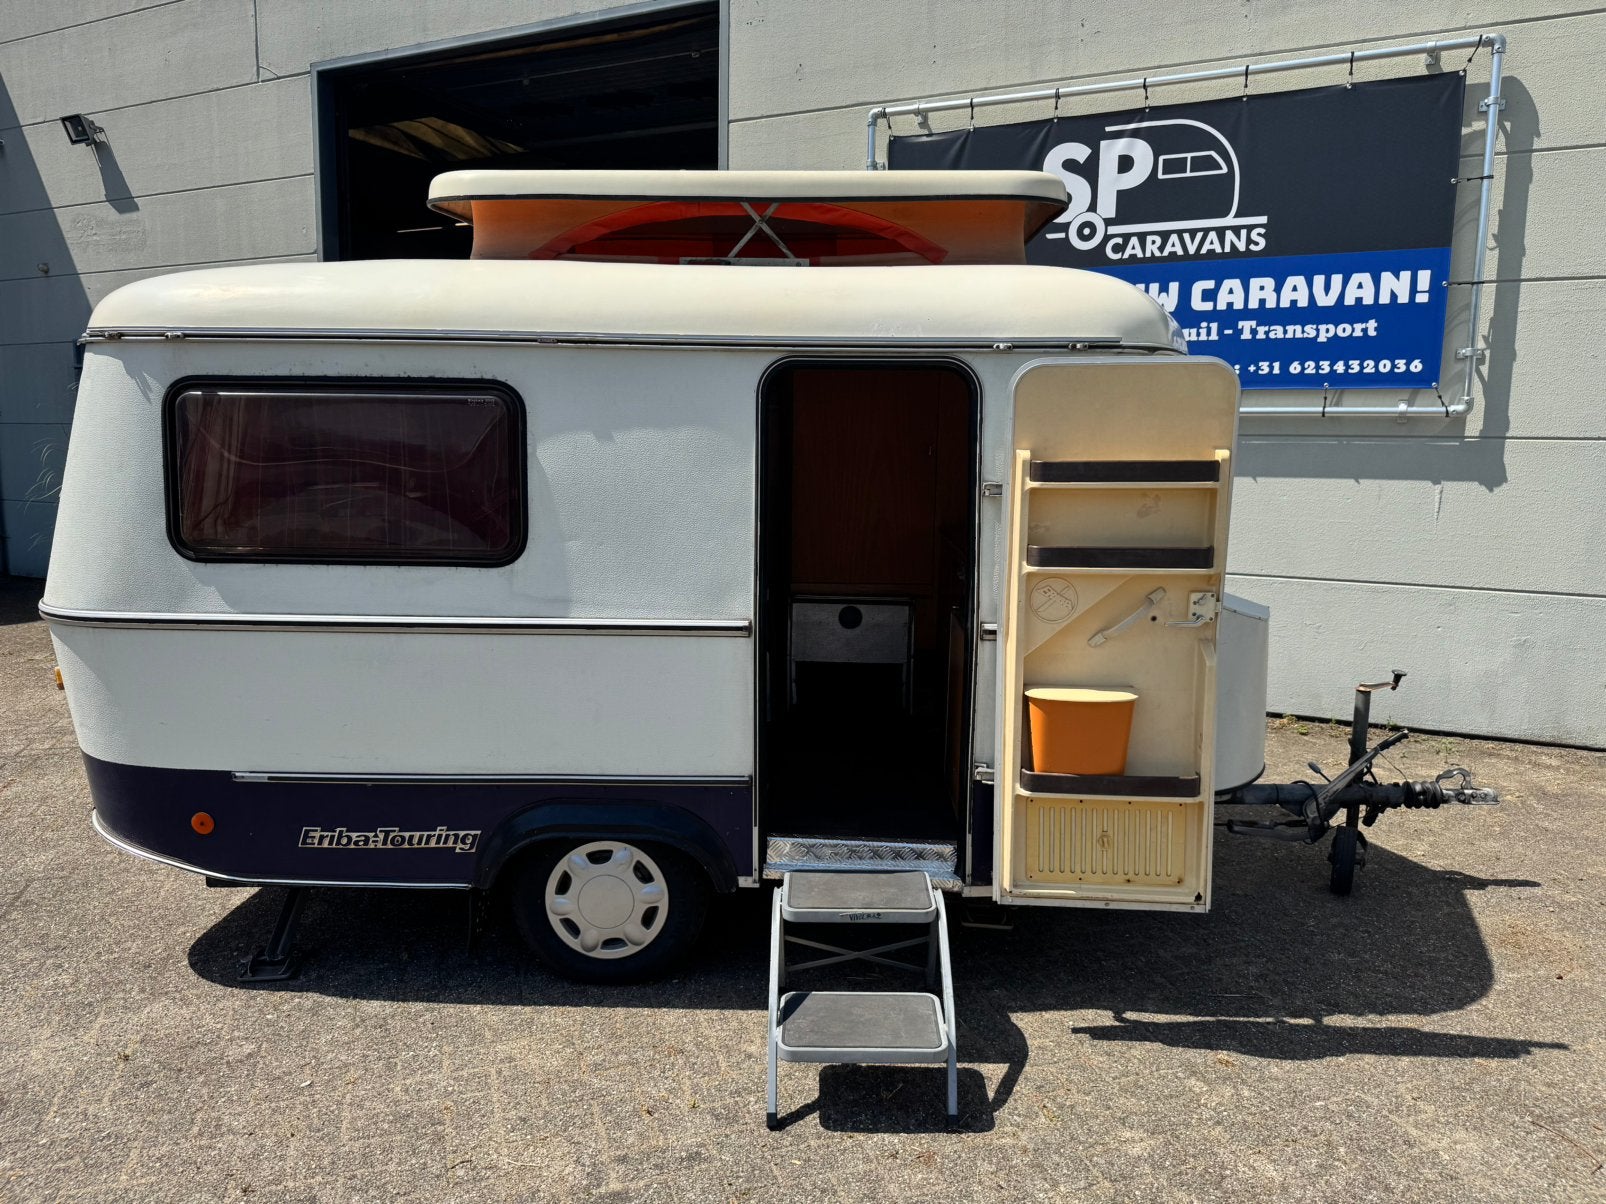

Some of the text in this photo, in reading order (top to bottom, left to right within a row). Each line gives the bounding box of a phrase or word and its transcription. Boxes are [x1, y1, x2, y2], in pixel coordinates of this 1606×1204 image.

[1043, 138, 1154, 223] SP
[1105, 228, 1267, 260] CARAVANS
[1136, 269, 1432, 313] W CARAVAN!
[1182, 321, 1219, 342] uil
[1238, 319, 1378, 342] Transport
[1248, 361, 1280, 374] +31
[1289, 359, 1424, 374] 623432036
